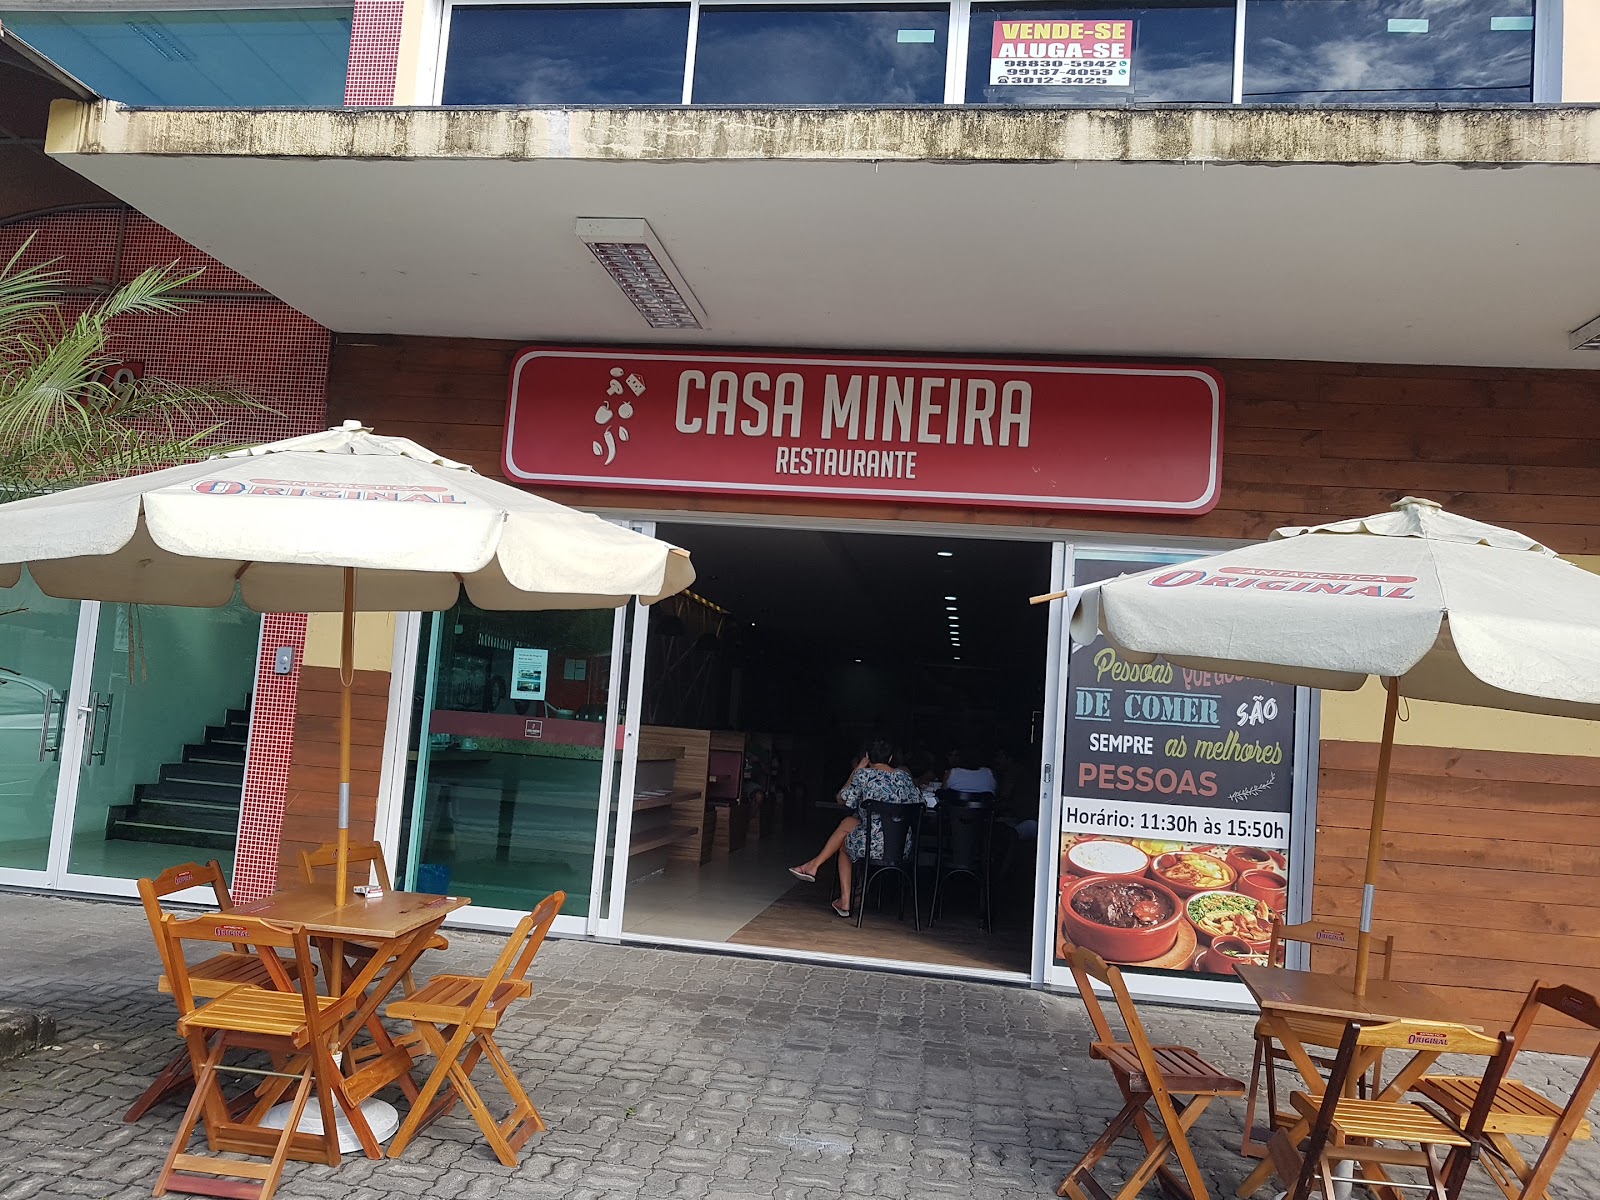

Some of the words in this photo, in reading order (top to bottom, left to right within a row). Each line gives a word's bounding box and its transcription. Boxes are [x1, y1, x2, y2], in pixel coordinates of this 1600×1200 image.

[1002, 23, 1126, 40] VENDE-SE
[998, 42, 1125, 58] ALUGA-SE
[1004, 60, 1117, 68] 98830-5942
[1006, 68, 1113, 76] 99137-4059
[675, 369, 805, 438] CASA
[820, 373, 1033, 448] MINEIRA
[775, 446, 918, 480] RESTAURANTE
[190, 479, 467, 505] ORIGINAL
[1147, 569, 1416, 600] ORIGINAL
[1239, 568, 1389, 582] ANTARCTICA
[1093, 647, 1174, 685] Pessoas
[1075, 690, 1112, 717] DE
[1123, 694, 1220, 724] COMER
[1236, 695, 1279, 727] SÃO
[1089, 733, 1154, 755] SEMPRE
[1164, 735, 1188, 758] as
[1194, 730, 1283, 765] melhores
[1078, 762, 1218, 797] PESSOAS
[1066, 807, 1135, 828] Horário:
[1140, 813, 1197, 833] 11:30h
[1203, 816, 1222, 835] às
[1227, 819, 1284, 840] 15:50h
[1408, 1035, 1449, 1046] ORIGINAL
